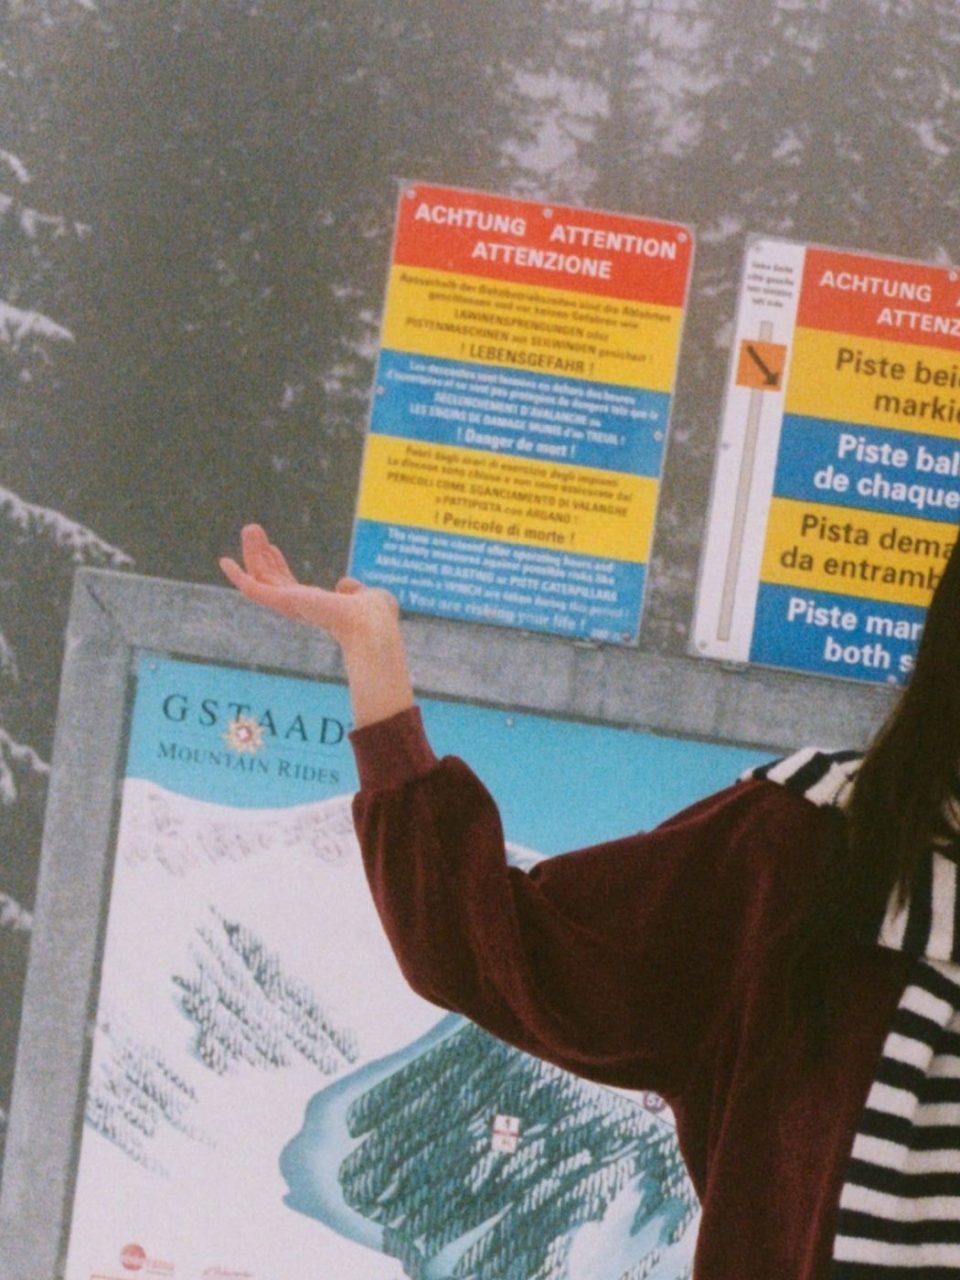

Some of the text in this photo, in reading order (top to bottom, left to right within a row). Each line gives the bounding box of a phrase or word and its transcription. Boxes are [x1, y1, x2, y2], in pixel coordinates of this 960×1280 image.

[414, 202, 676, 259] ACHTUNG ATTENTION
[471, 241, 611, 278] ATTENZIONE
[819, 269, 931, 302] ACHTUNG
[469, 344, 584, 372] LEBENSGEFAHR
[835, 347, 905, 380] Piste
[464, 427, 513, 450] Danger
[515, 437, 533, 451] de
[535, 442, 567, 456] mort
[569, 443, 576, 456] !
[837, 433, 908, 467] Piste
[386, 471, 433, 486] PERICOLI
[436, 479, 465, 492] COME
[572, 500, 627, 516] VALANGHE
[813, 465, 960, 509] de chaque
[526, 508, 570, 523] ARGANO
[800, 513, 869, 545] Pista
[506, 523, 519, 536] di
[523, 528, 565, 544] morte
[779, 545, 813, 571] da
[408, 591, 436, 607] You
[437, 599, 462, 612] are
[464, 603, 515, 623] risking
[515, 611, 549, 625] your
[552, 614, 576, 629] life
[787, 596, 857, 630] Piste
[823, 636, 890, 668] both
[162, 693, 345, 746] GSTAAD
